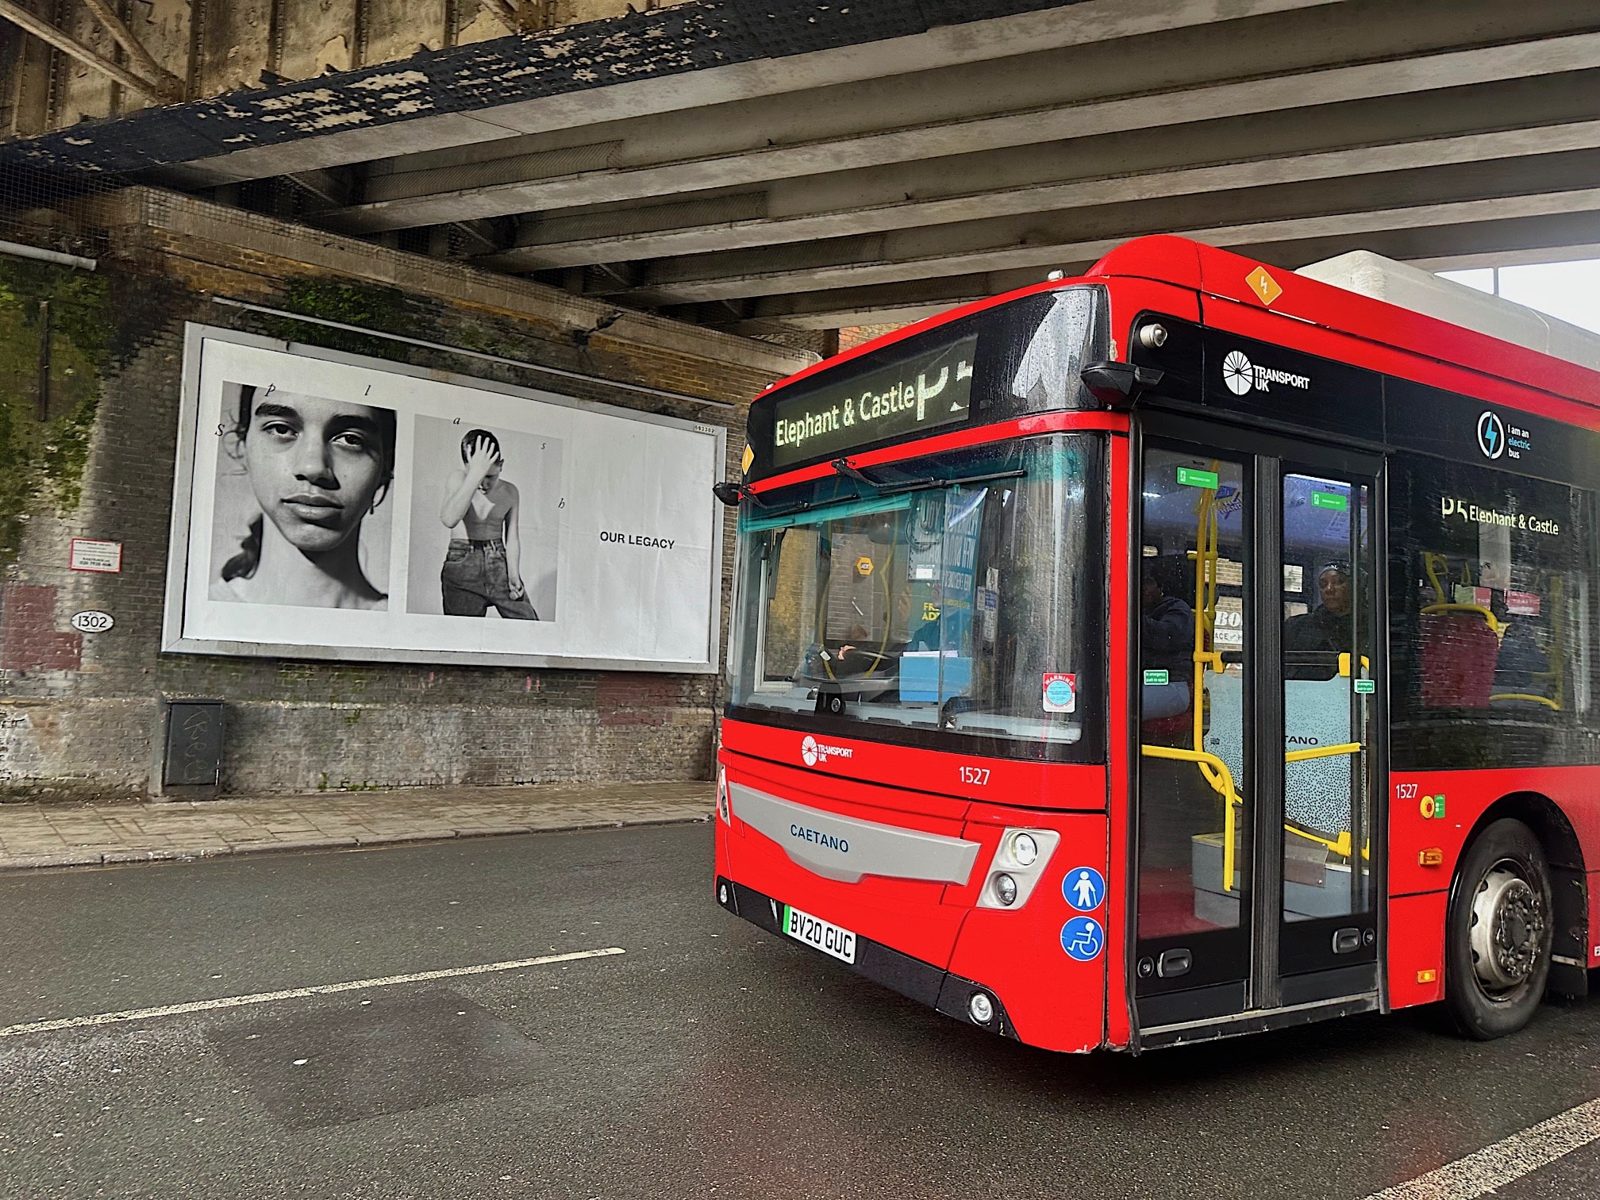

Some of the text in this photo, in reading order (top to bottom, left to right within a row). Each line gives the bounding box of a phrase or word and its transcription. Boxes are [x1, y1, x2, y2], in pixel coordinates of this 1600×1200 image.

[1252, 364, 1310, 390] TRANSPORT
[1254, 377, 1270, 393] UK
[775, 404, 840, 448] Elephant
[843, 398, 855, 427] &
[859, 381, 915, 421] Castle
[1511, 427, 1521, 436] am
[1521, 430, 1530, 439] an
[1507, 437, 1531, 450] electric
[1508, 447, 1520, 459] bus
[1469, 505, 1517, 528] Elephant
[1518, 513, 1527, 530] &
[1528, 515, 1559, 535] Castle
[600, 531, 675, 550] OUR LEGACY
[78, 615, 108, 628] 1302
[817, 744, 853, 759] TRANSPORT
[818, 753, 828, 763] UK
[959, 766, 991, 786] 1527
[1395, 783, 1418, 799] 1527
[790, 824, 849, 853] CAETANO
[790, 911, 852, 958] BV20 GUC
